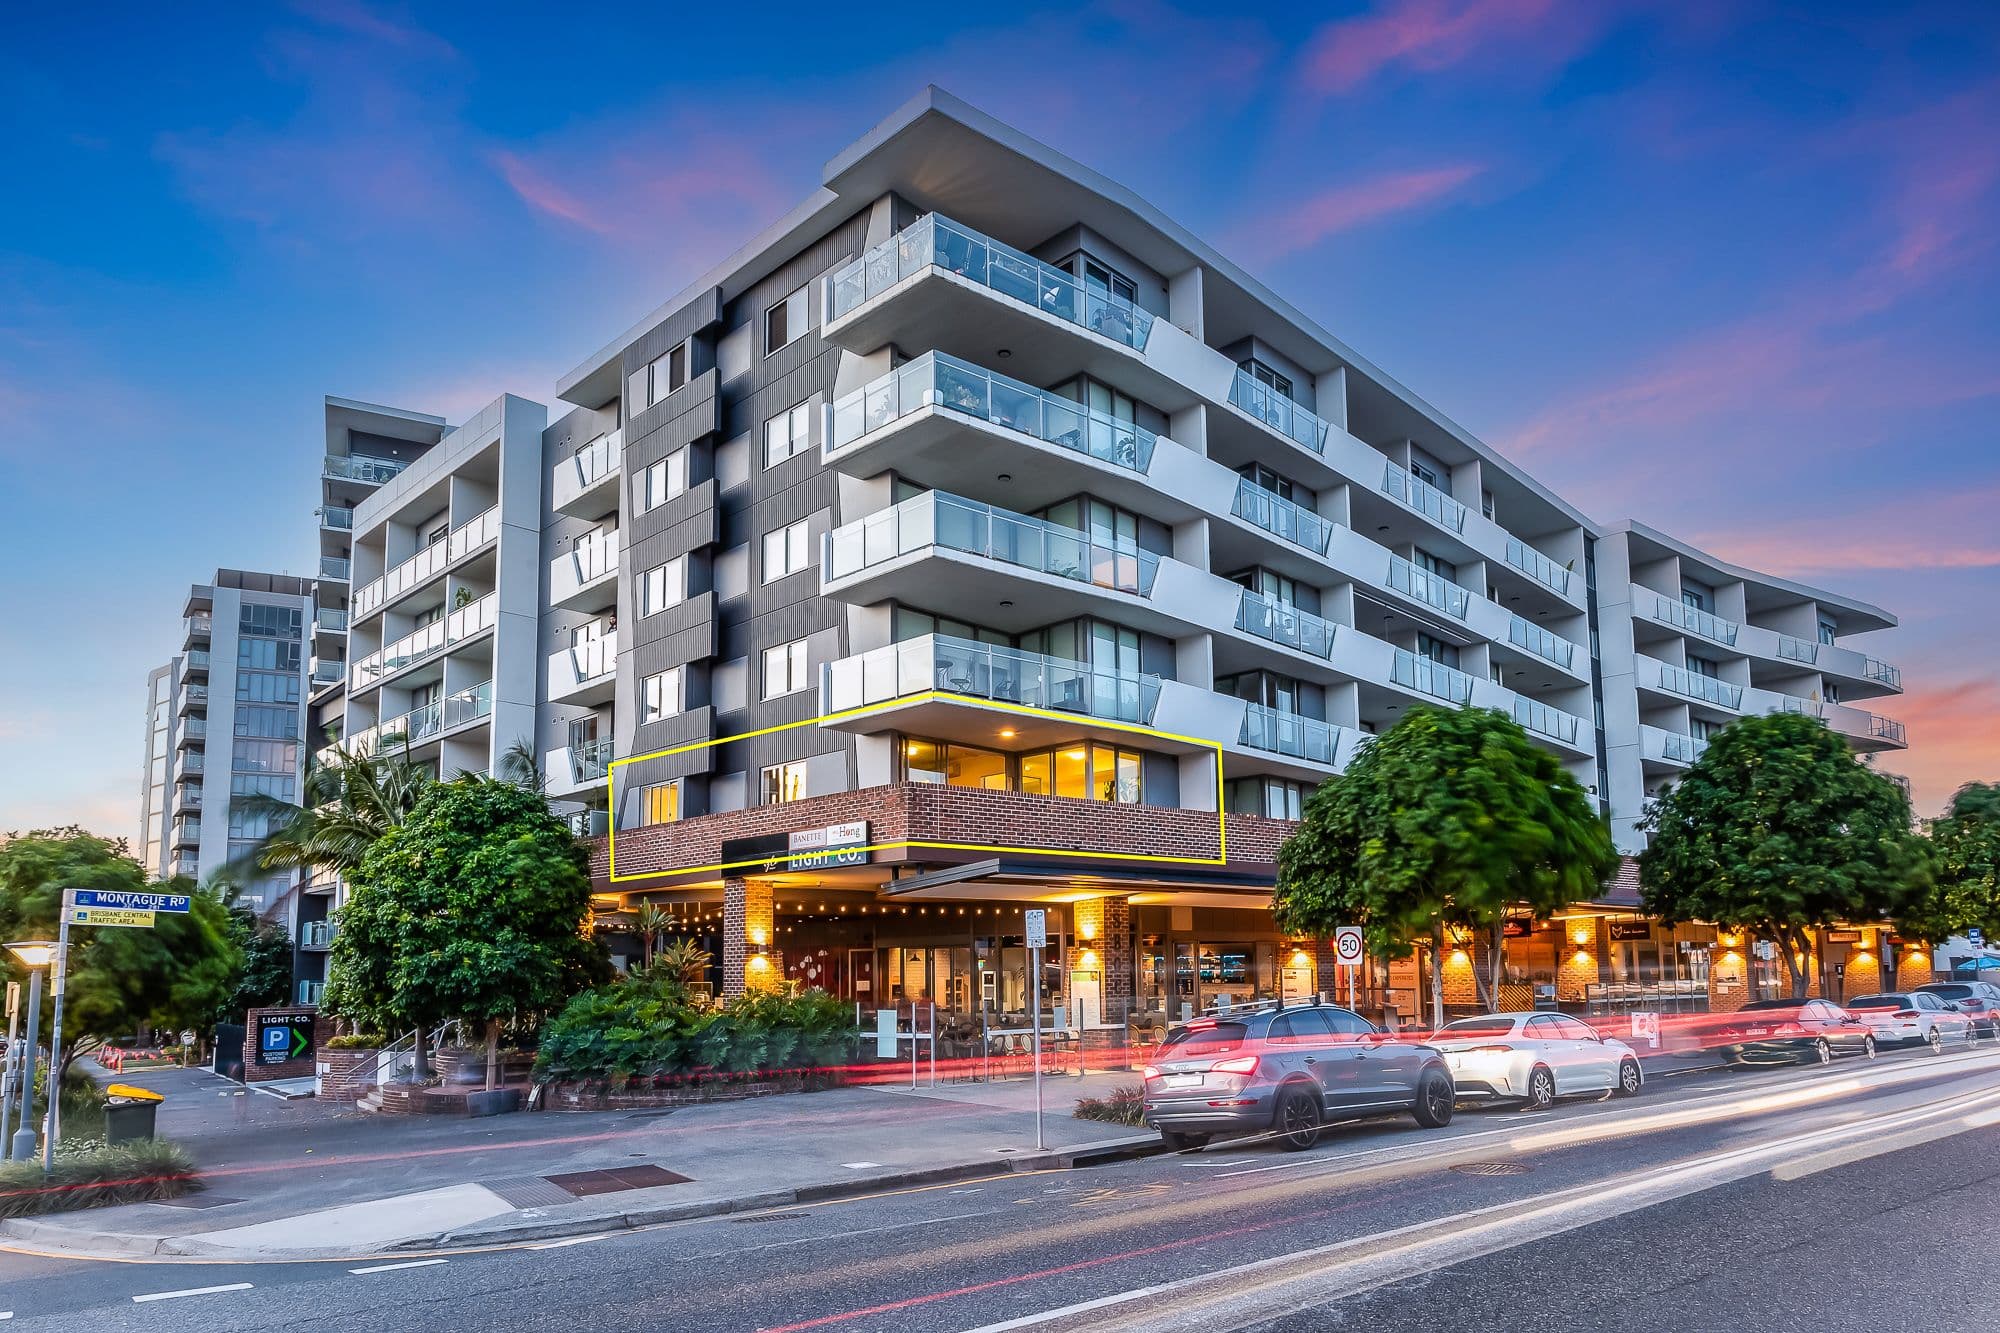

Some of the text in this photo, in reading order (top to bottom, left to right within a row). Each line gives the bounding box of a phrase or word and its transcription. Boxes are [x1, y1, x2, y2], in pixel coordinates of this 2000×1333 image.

[793, 832, 822, 844] BANETTE
[839, 826, 861, 838] Hong
[792, 850, 830, 868] LIGHT
[837, 846, 862, 863] CO.
[96, 892, 185, 907] MONTAGUE RD
[89, 910, 151, 919] BRISBANE CENTRAL
[1341, 939, 1357, 952] 50
[262, 1015, 311, 1024] LIGHT CO.
[269, 1030, 284, 1047] P
